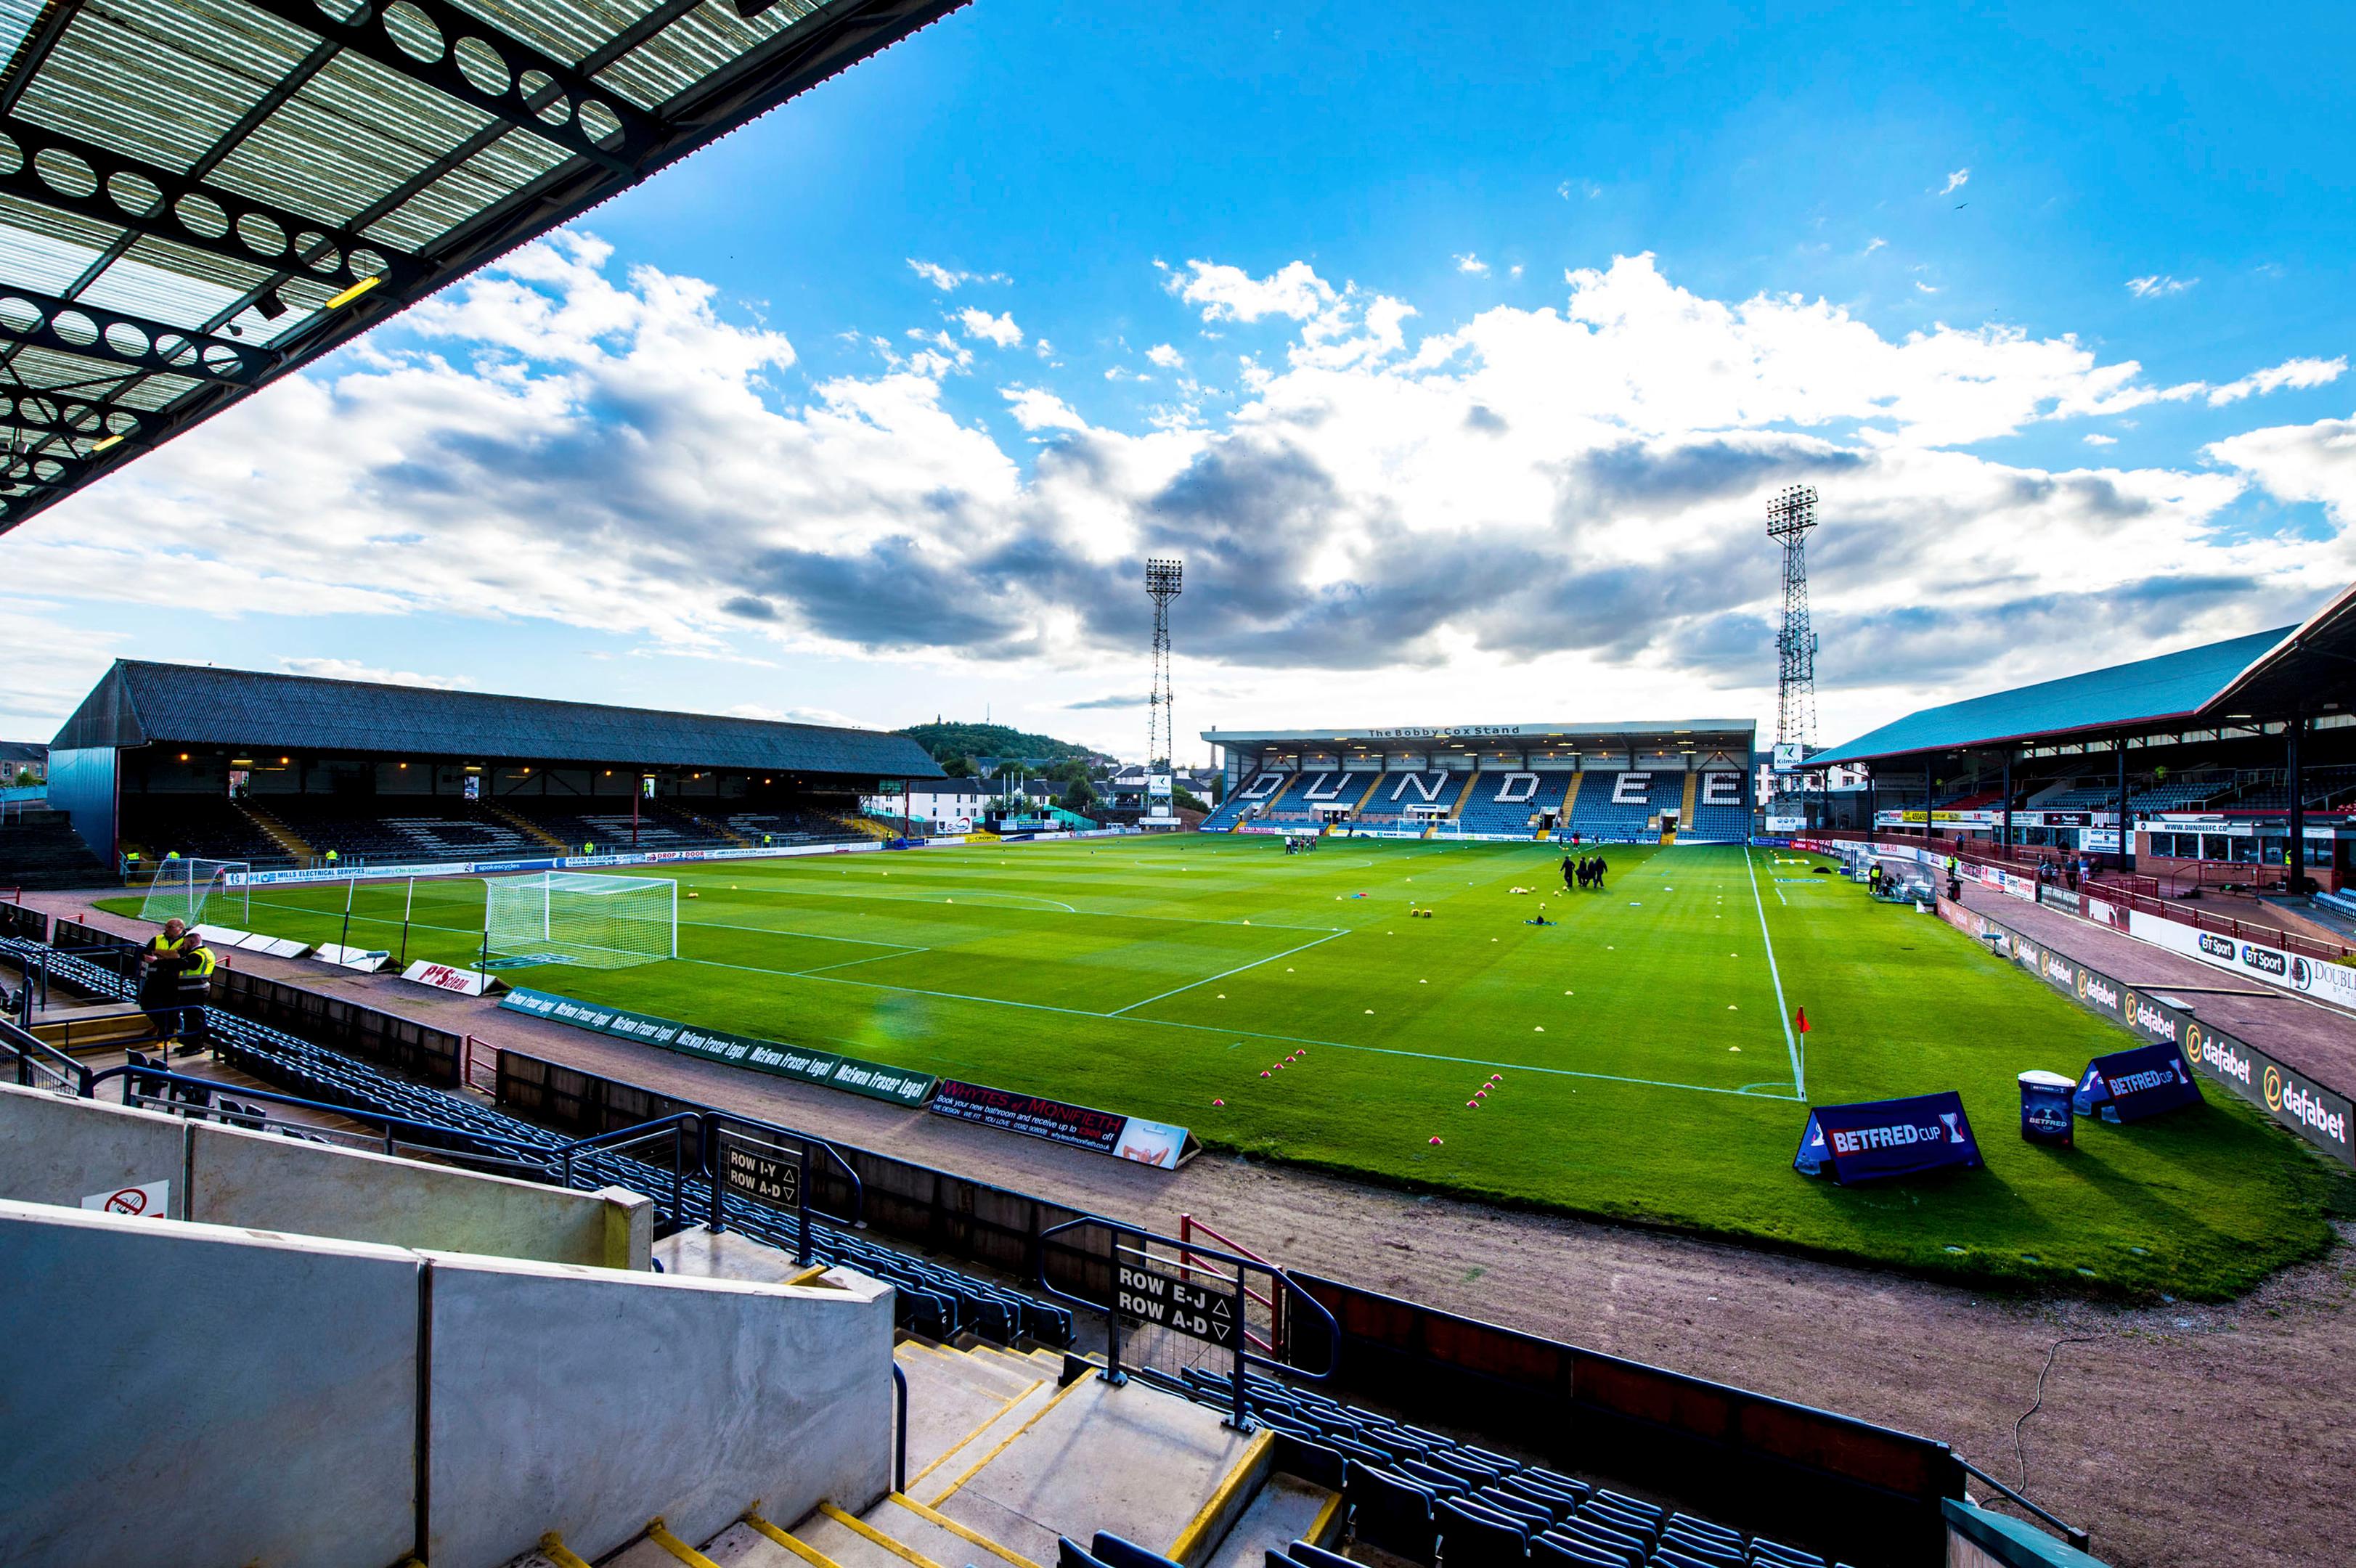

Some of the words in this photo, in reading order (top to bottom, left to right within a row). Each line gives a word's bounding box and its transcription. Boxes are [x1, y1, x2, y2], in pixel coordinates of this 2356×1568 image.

[1395, 728, 1438, 737] Bobby
[1475, 726, 1520, 735] Stand
[1239, 772, 1742, 807] DUNDEE
[478, 862, 520, 873] spokescycles
[2019, 940, 2037, 965] dafabet
[2202, 937, 2213, 950] BT
[2212, 939, 2232, 957] Sport
[2246, 950, 2258, 963] BT
[2258, 952, 2282, 971] Sport
[2048, 957, 2072, 985] dafabet
[2315, 961, 2356, 990] DOUBL
[504, 992, 528, 1005] McEwan
[522, 995, 543, 1009] Fraser
[537, 999, 557, 1013] Legal
[2086, 977, 2118, 1010] dafabet
[553, 1003, 579, 1016] McEwan
[574, 1006, 598, 1022] Fraser
[592, 1012, 613, 1026] Legal
[610, 1016, 638, 1032] McEwan
[633, 1021, 659, 1037] Fraser
[653, 1025, 677, 1042] Legal
[2137, 1003, 2176, 1042] dafabet
[675, 1030, 704, 1049] McEwan
[701, 1036, 729, 1054] Fraser
[724, 1042, 749, 1060] Legal
[749, 1047, 783, 1066] McEwan
[780, 1052, 811, 1072] Fraser
[806, 1058, 834, 1078] Legal
[2202, 1036, 2251, 1085] dafabet
[834, 1064, 873, 1088] McEwan
[868, 1071, 902, 1093] Fraser
[897, 1078, 928, 1100] Legal
[2109, 1070, 2161, 1097] BETFRED
[2160, 1071, 2174, 1084] CUP
[937, 1095, 954, 1104] Book
[953, 1099, 969, 1108] your
[969, 1103, 985, 1112] new
[985, 1105, 1016, 1119] bathroom
[1016, 1113, 1031, 1122] and
[1032, 1116, 1058, 1129] receive
[1059, 1123, 1069, 1132] up
[1069, 1124, 1077, 1133] to
[1101, 1132, 1115, 1142] off
[942, 1106, 961, 1115] DESIGN
[995, 1118, 1011, 1127] LOVE
[1013, 1122, 1028, 1132] 01382
[945, 1080, 1009, 1106] WHYTES
[1027, 1098, 1122, 1132] MONIFIETH
[2282, 1080, 2347, 1144] dafabet
[2029, 1116, 2067, 1127] BETFRED
[1833, 1124, 1918, 1153] BETFRED
[1918, 1126, 1941, 1142] CUP
[730, 1151, 756, 1172] ROW
[760, 1161, 776, 1177] I-Y
[730, 1169, 756, 1190] ROW
[759, 1180, 781, 1198] A-D
[1120, 1267, 1165, 1296] ROW
[1173, 1284, 1205, 1309] E-J
[1119, 1291, 1165, 1320] ROW
[1172, 1310, 1207, 1334] A-D
